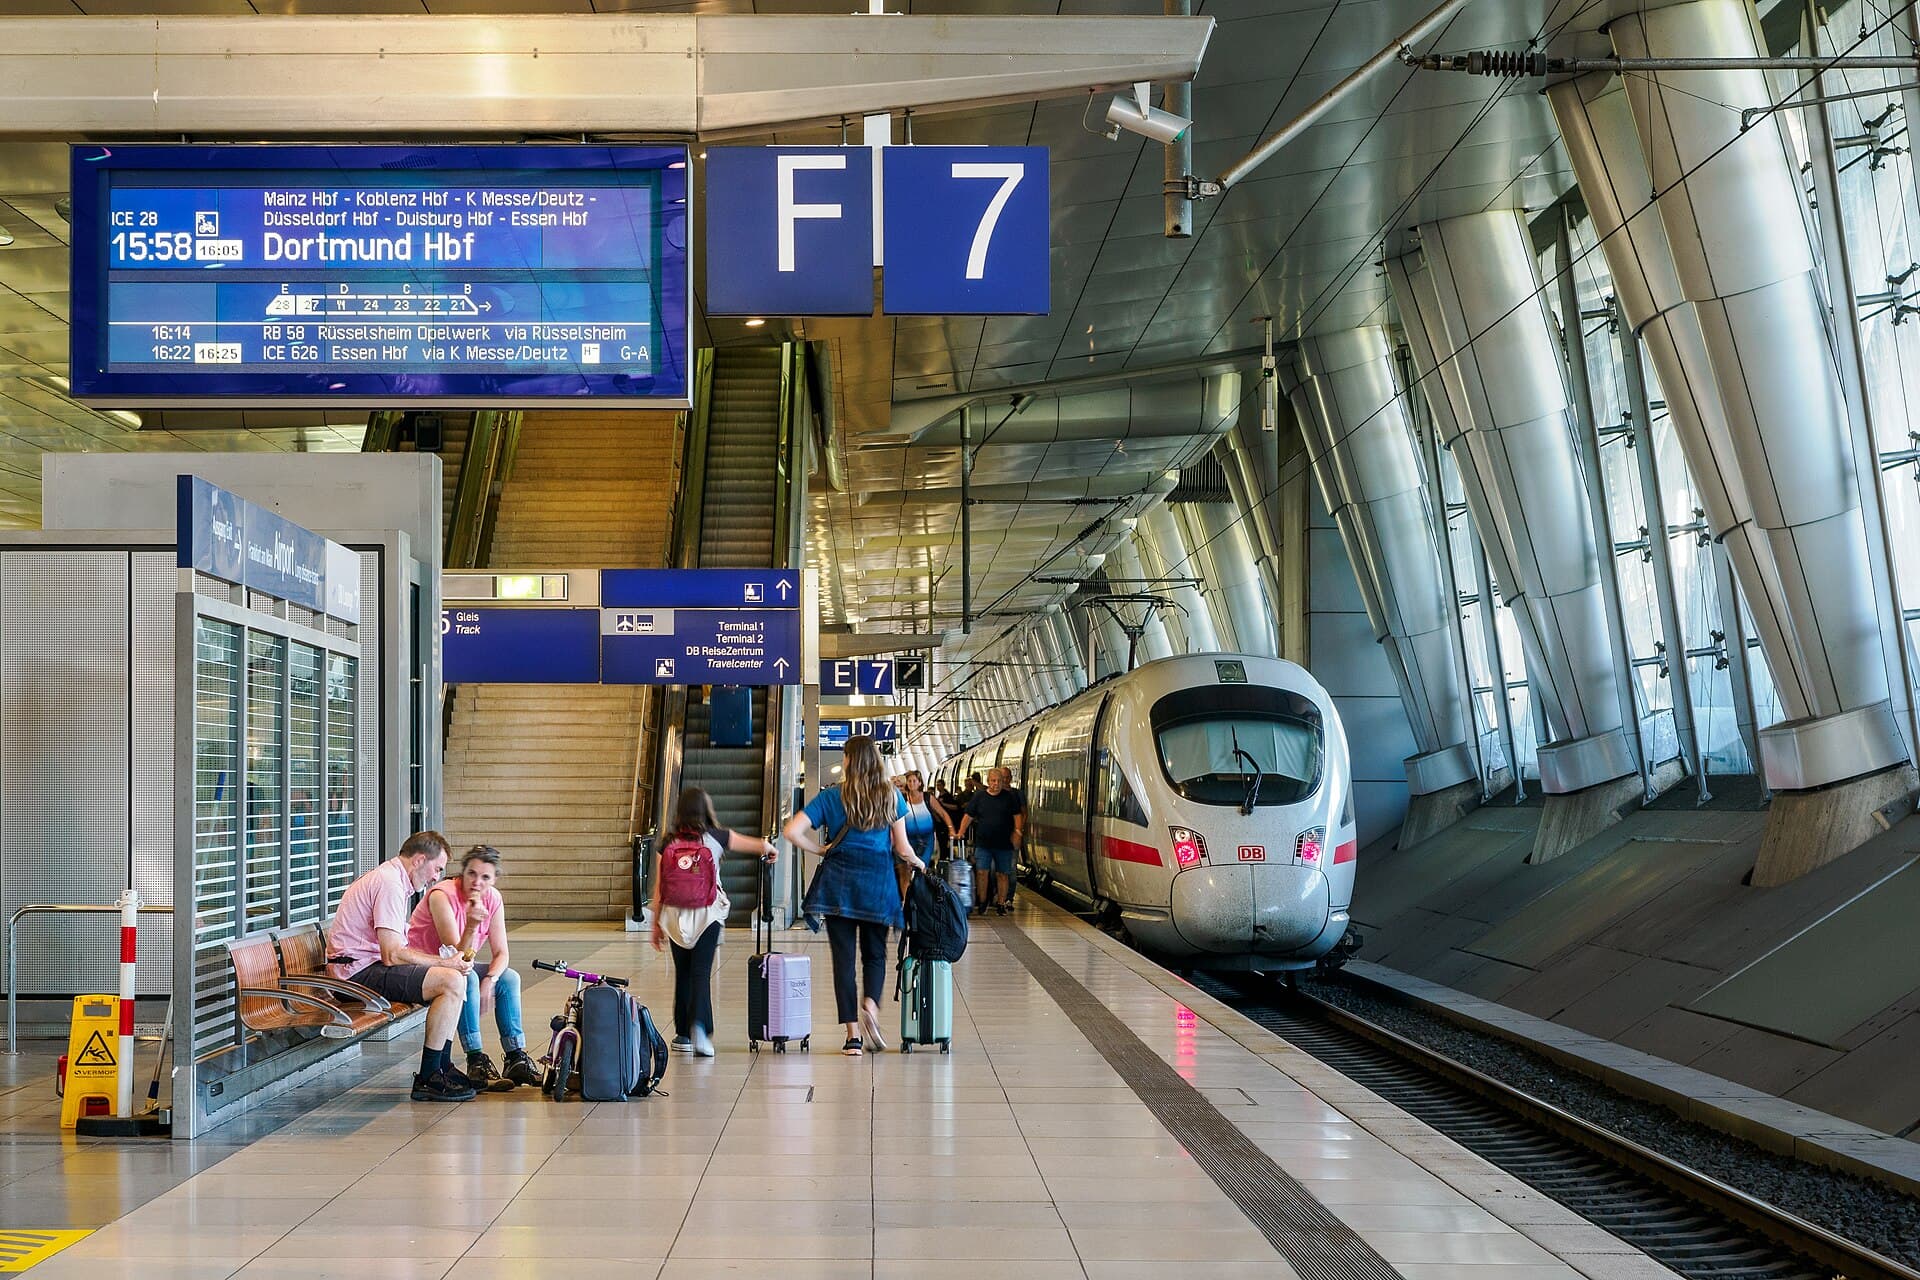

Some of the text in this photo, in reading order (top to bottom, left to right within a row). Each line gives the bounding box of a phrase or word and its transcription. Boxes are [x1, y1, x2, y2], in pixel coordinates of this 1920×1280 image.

[264, 192, 306, 206] Mainz
[312, 192, 338, 206] Hbf
[356, 192, 416, 206] Koblenz
[422, 192, 448, 206] Hbf
[466, 192, 477, 206] K
[483, 192, 584, 206] Messe/Deutz
[111, 212, 158, 226] ICE 28
[264, 211, 346, 226] Düsseldorf
[352, 212, 378, 226] Hbf
[396, 212, 462, 228] Duisburg
[467, 212, 493, 226] Hbf
[511, 212, 557, 226] Essen
[562, 212, 588, 226] Hbf
[777, 155, 846, 272] F
[952, 163, 1025, 279] 7
[111, 232, 192, 261] 15:58
[199, 245, 239, 256] 16:05
[264, 232, 475, 261] Dortmund Hbf
[281, 284, 471, 294] E D C B
[275, 300, 465, 310] 28 27 24 23 22 21
[151, 326, 626, 344] 16:14 RB 58 Rüsselsheim Opelwerk via Rüsselsheim
[151, 346, 191, 360] 16:22
[198, 349, 238, 359] 16:25
[263, 346, 285, 360] ICE
[291, 346, 318, 360] 626
[332, 346, 376, 360] Essen
[382, 346, 408, 360] Hbf
[422, 346, 444, 360] via
[450, 346, 461, 360] K
[466, 346, 567, 360] Messe/Deutz
[620, 346, 649, 360] G-A
[273, 530, 294, 582] Airport
[456, 612, 480, 621] Gleis
[455, 624, 480, 634] Track
[718, 622, 764, 630] Terminal 1
[716, 634, 764, 643] Terminal 2
[686, 646, 764, 656] DB ReiseZentrum
[707, 659, 764, 668] Travelcenter
[834, 661, 851, 687] E
[871, 663, 888, 689] 7
[861, 722, 873, 736] D
[882, 722, 893, 737] 7
[1240, 847, 1263, 859] DB
